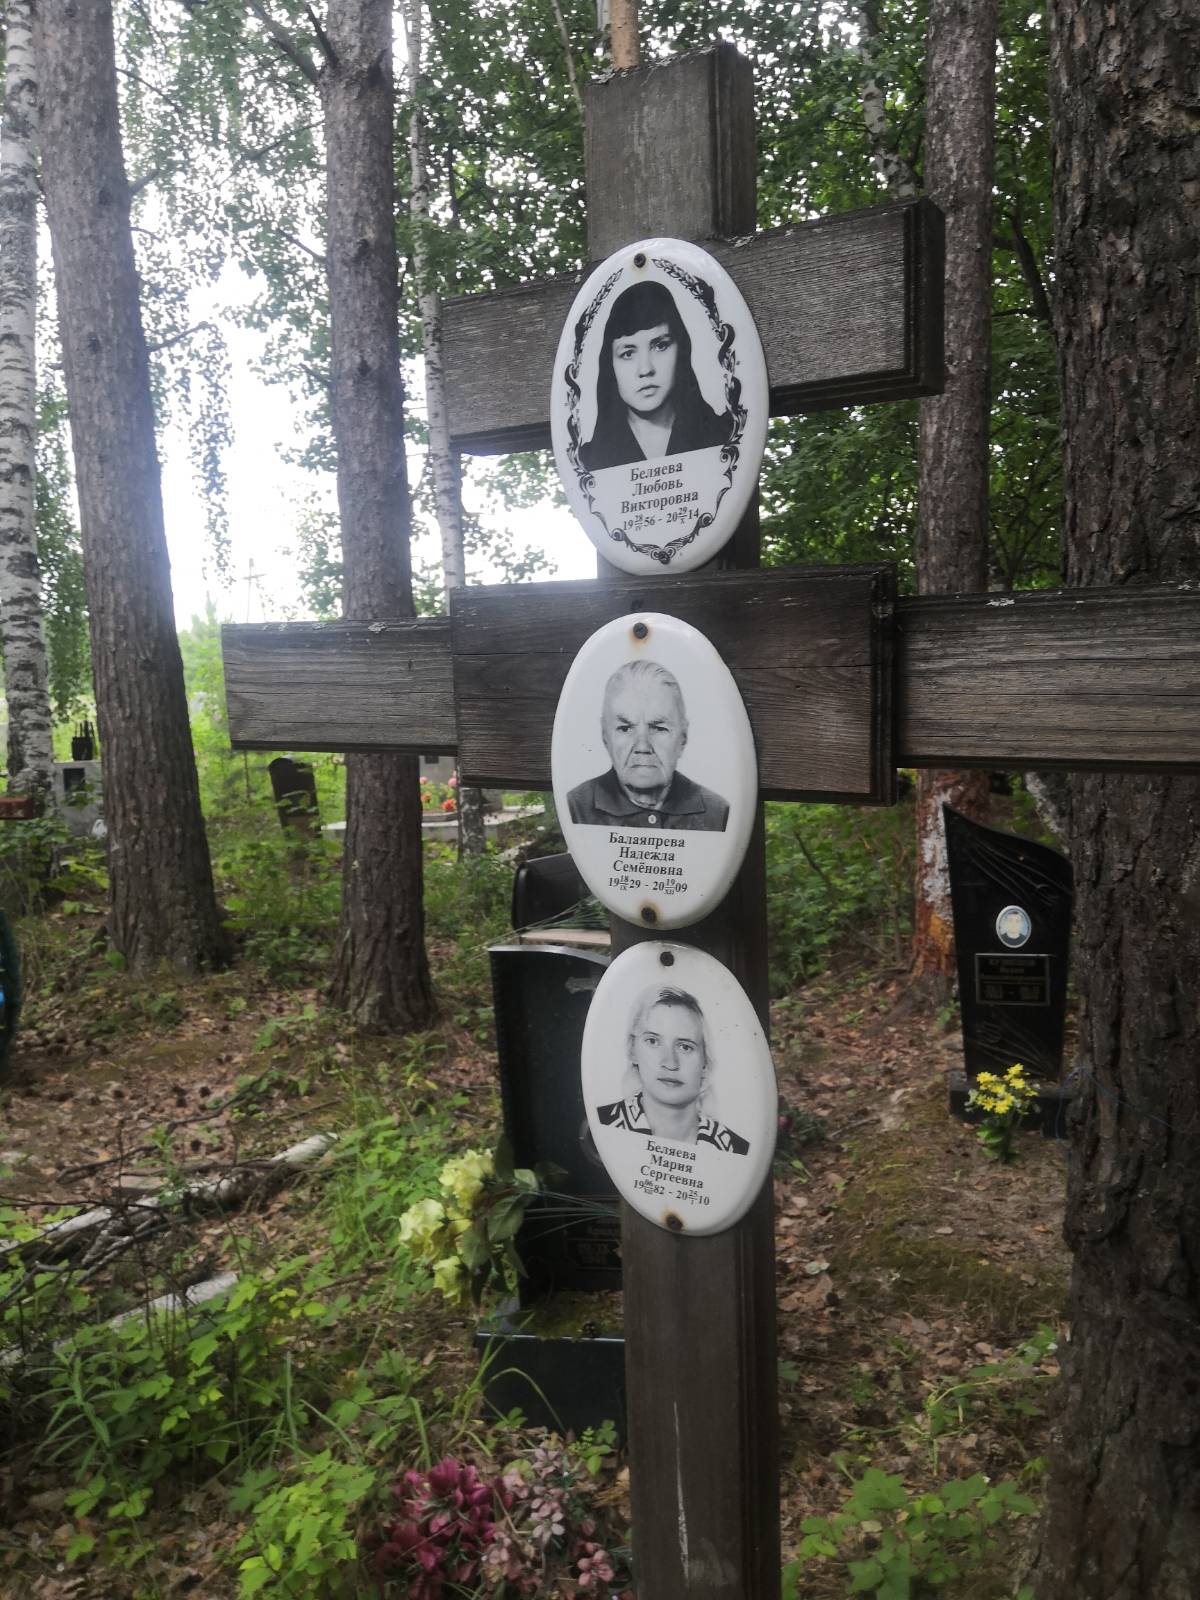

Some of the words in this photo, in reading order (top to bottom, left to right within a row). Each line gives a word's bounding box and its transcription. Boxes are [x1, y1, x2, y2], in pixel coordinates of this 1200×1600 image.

[630, 462, 683, 481] Беляева
[632, 478, 683, 496] Любовь
[621, 491, 699, 514] Викторовна
[619, 846, 675, 862] Надежда
[613, 859, 683, 876] Семёновна
[646, 1140, 696, 1161] Беляева
[650, 1154, 693, 1174] Мария
[640, 1165, 704, 1189] Сергеевна
